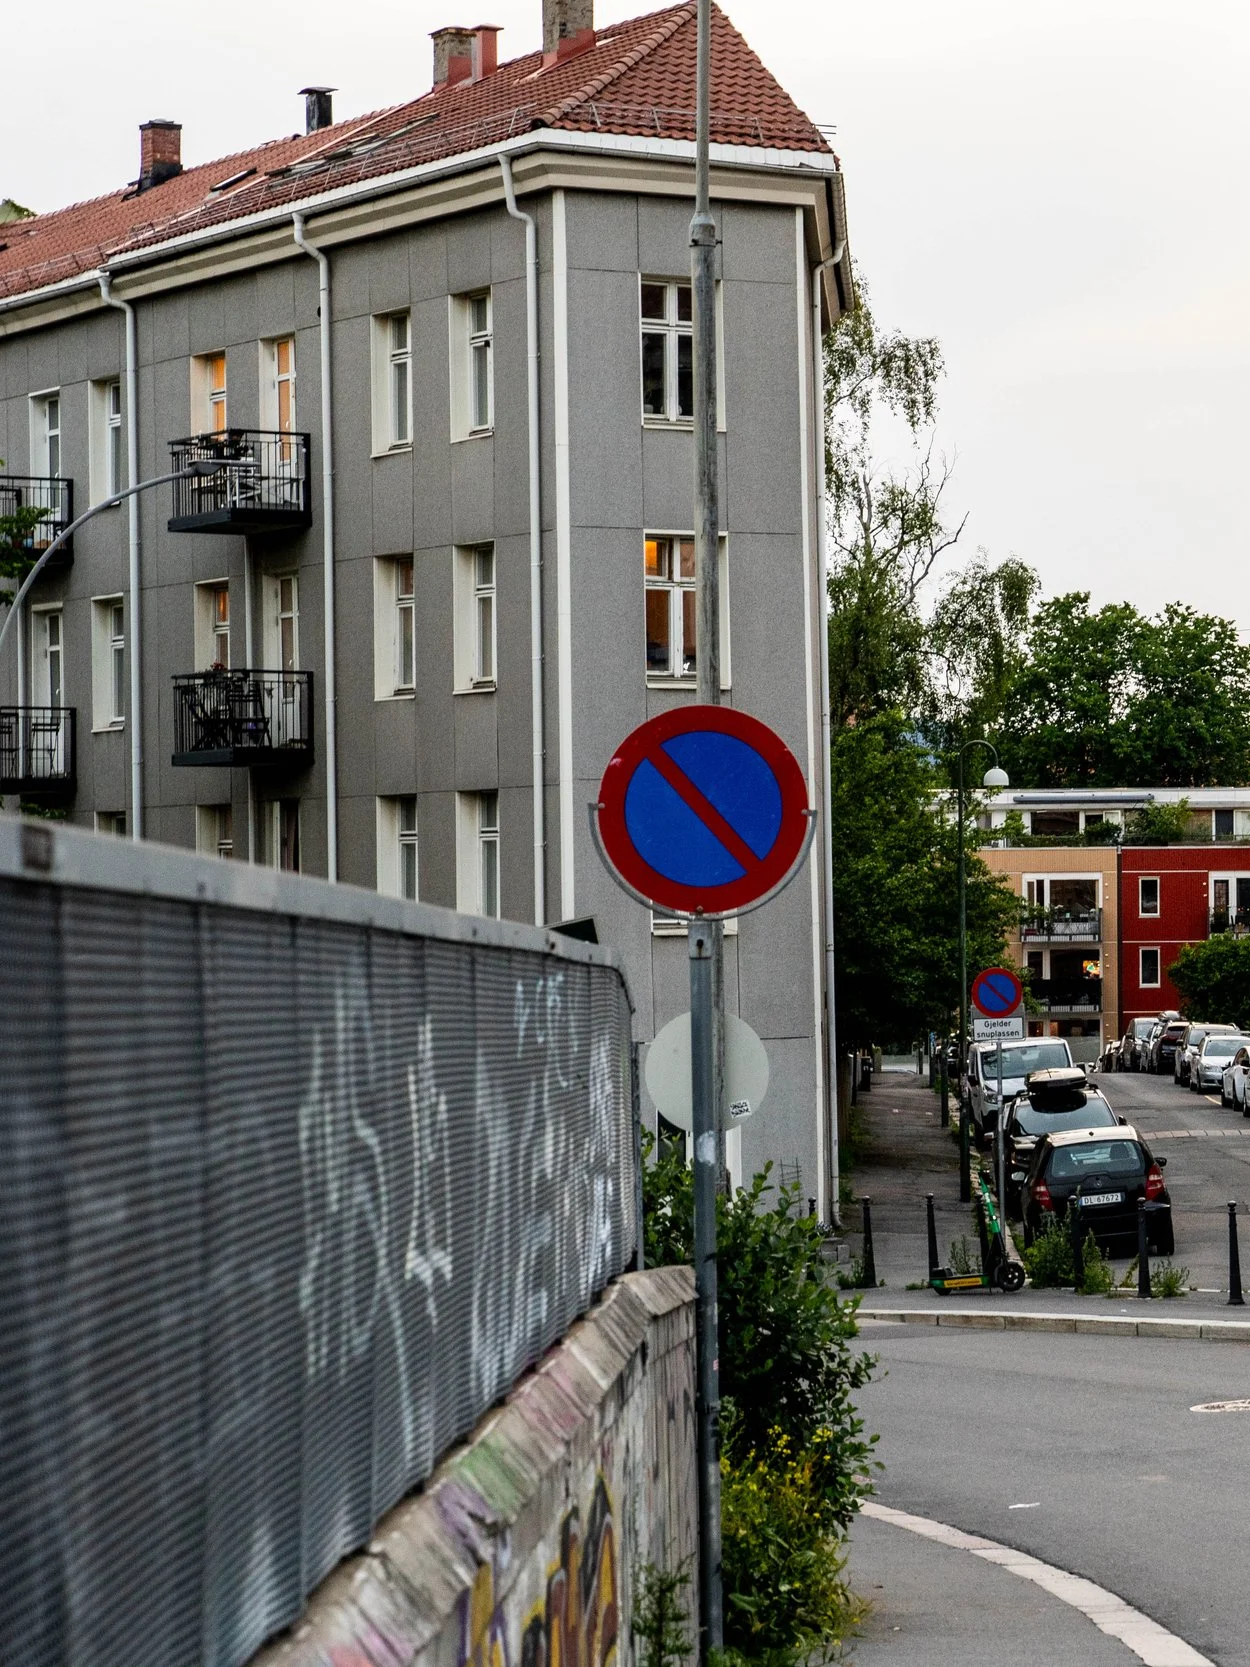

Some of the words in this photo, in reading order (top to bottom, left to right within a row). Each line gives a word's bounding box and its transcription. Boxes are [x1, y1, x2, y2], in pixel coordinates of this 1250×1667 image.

[984, 1020, 1012, 1029] Gjelder
[976, 1030, 1020, 1039] snuplassen
[1096, 1193, 1119, 1203] 67672
